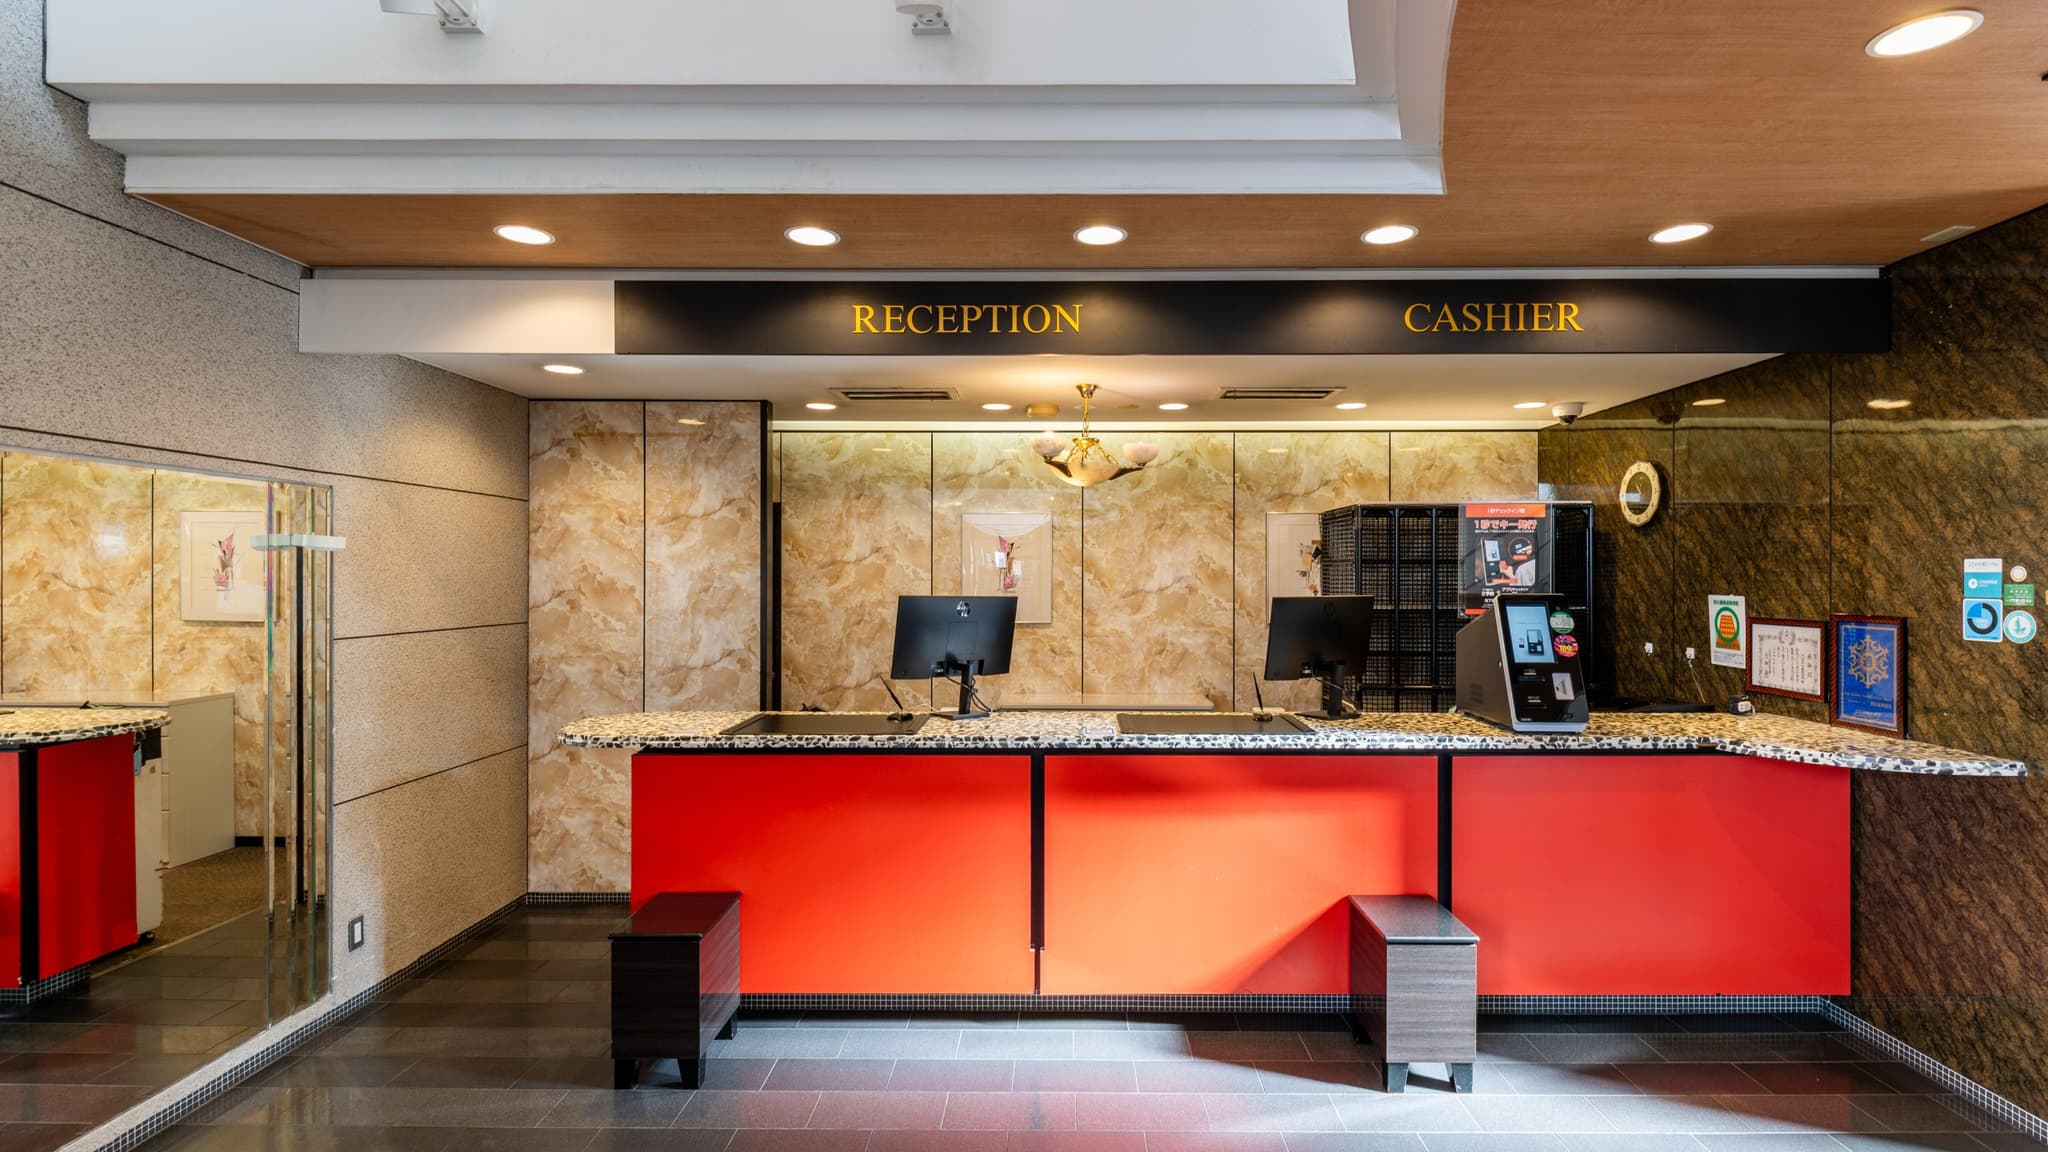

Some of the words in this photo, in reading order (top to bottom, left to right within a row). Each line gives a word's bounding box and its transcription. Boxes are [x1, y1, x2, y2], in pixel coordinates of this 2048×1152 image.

[851, 304, 1084, 334] RECEPTION
[1403, 302, 1584, 333] CASHIER
[1474, 519, 1538, 530] 1秒でキー発行
